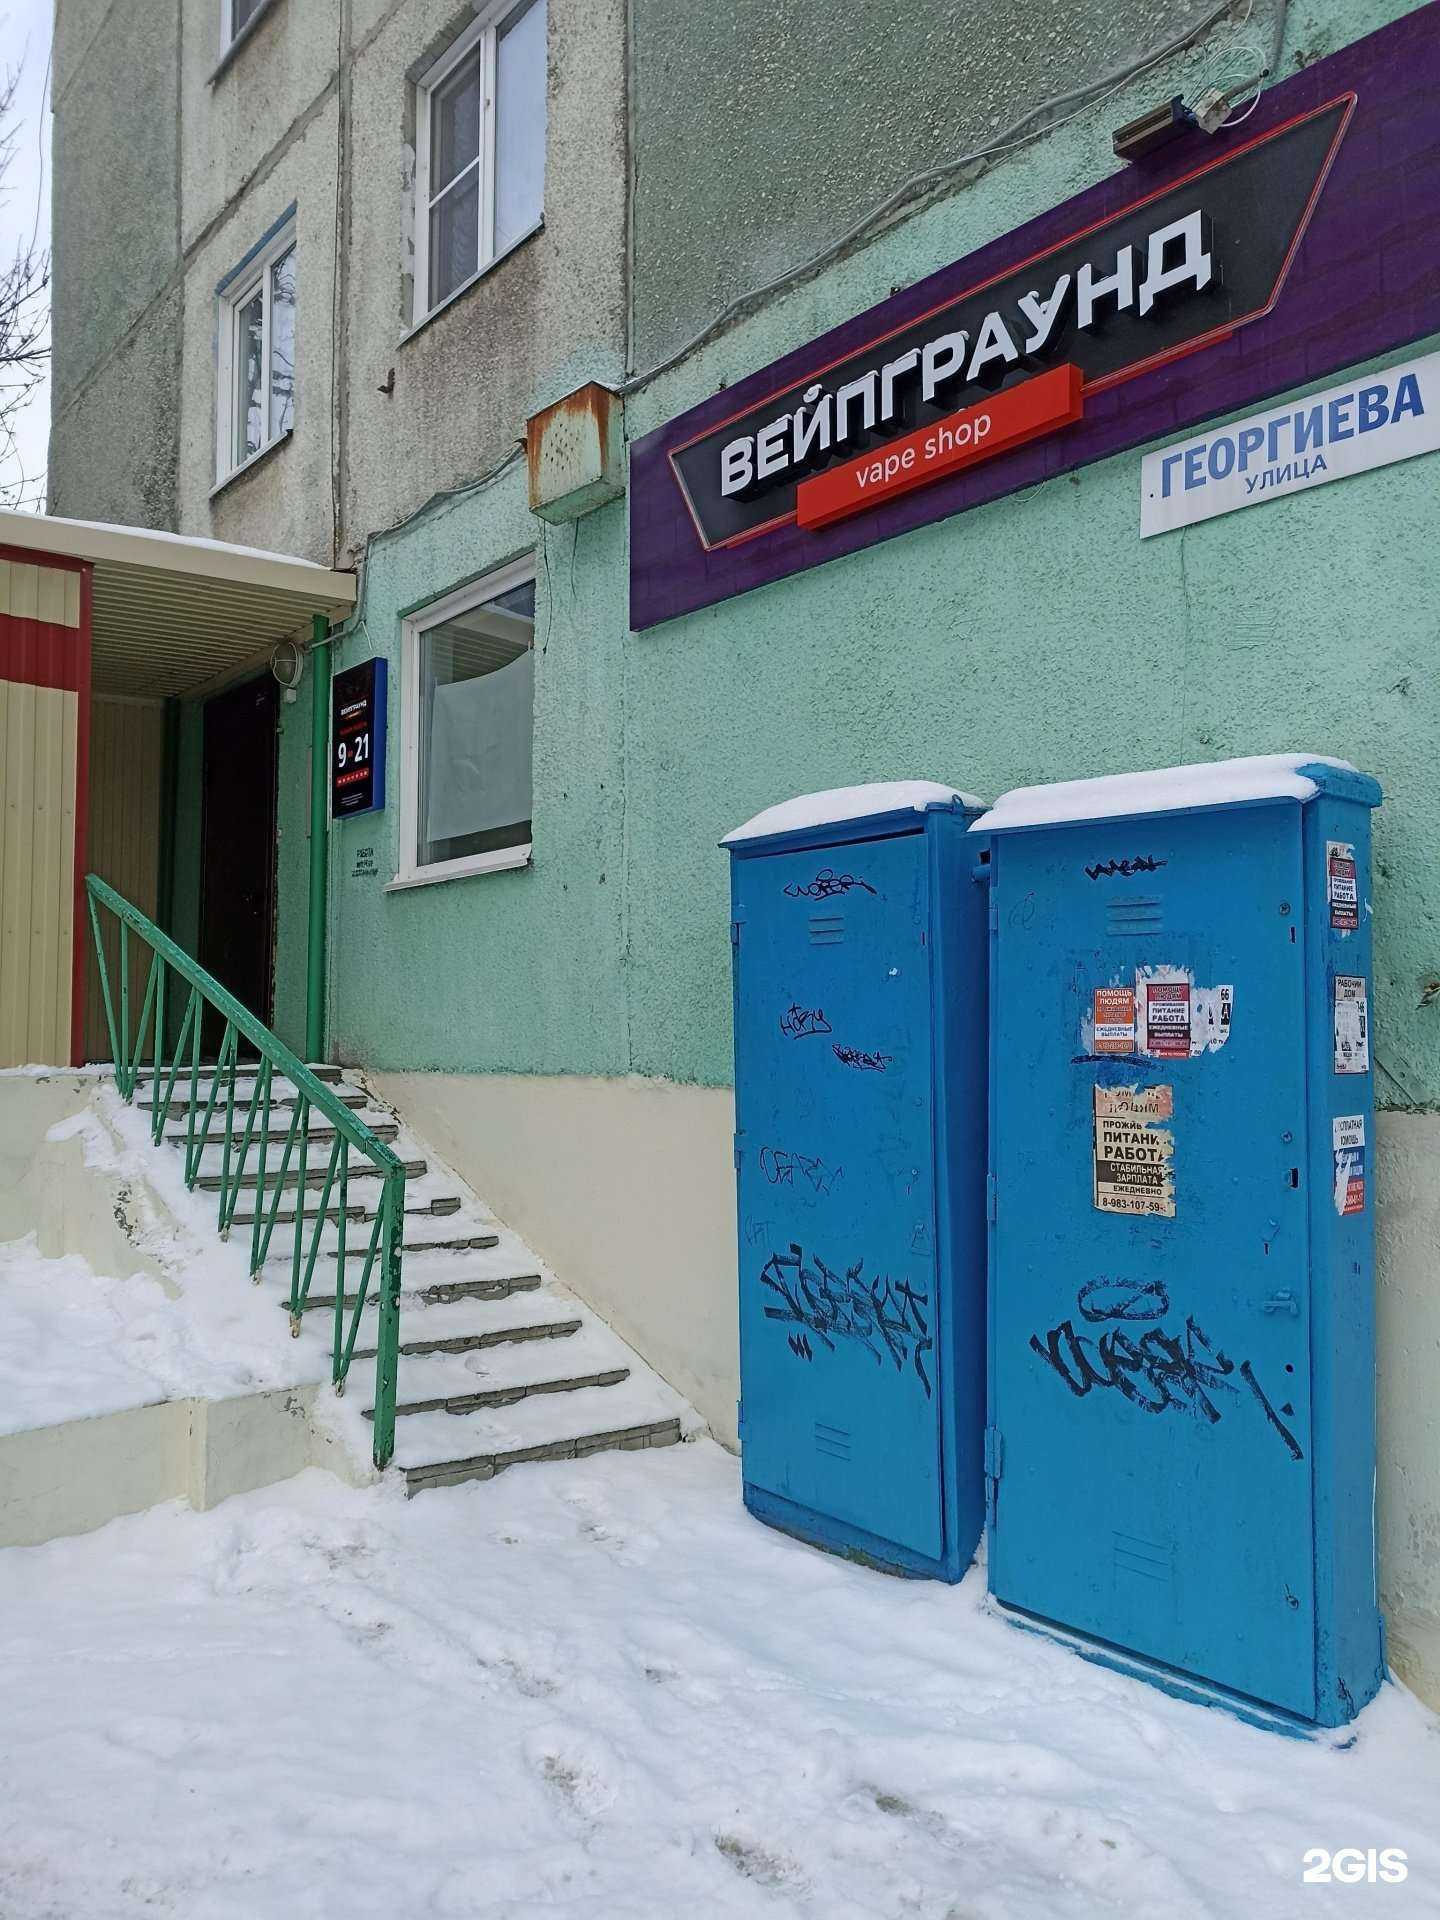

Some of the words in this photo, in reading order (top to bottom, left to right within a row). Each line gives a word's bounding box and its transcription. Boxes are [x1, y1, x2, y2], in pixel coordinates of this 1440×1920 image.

[720, 208, 1213, 498] ВЕЙПГРАУНД
[1162, 373, 1424, 498] ГЕОРГИЕВА
[856, 447, 915, 488] vape
[924, 414, 991, 460] shop
[1245, 454, 1327, 494] УЛИЦА
[338, 742, 347, 768] 9
[354, 733, 369, 763] 21
[1096, 990, 1133, 998] ПОМОЩЬ
[1099, 997, 1130, 1006] ЛЮДЯМ
[1152, 1014, 1185, 1022] РАБОТА
[1113, 1185, 1162, 1196] ЕЖЕДНЕВНО
[1116, 1175, 1158, 1184] ЗАРПЛАТА
